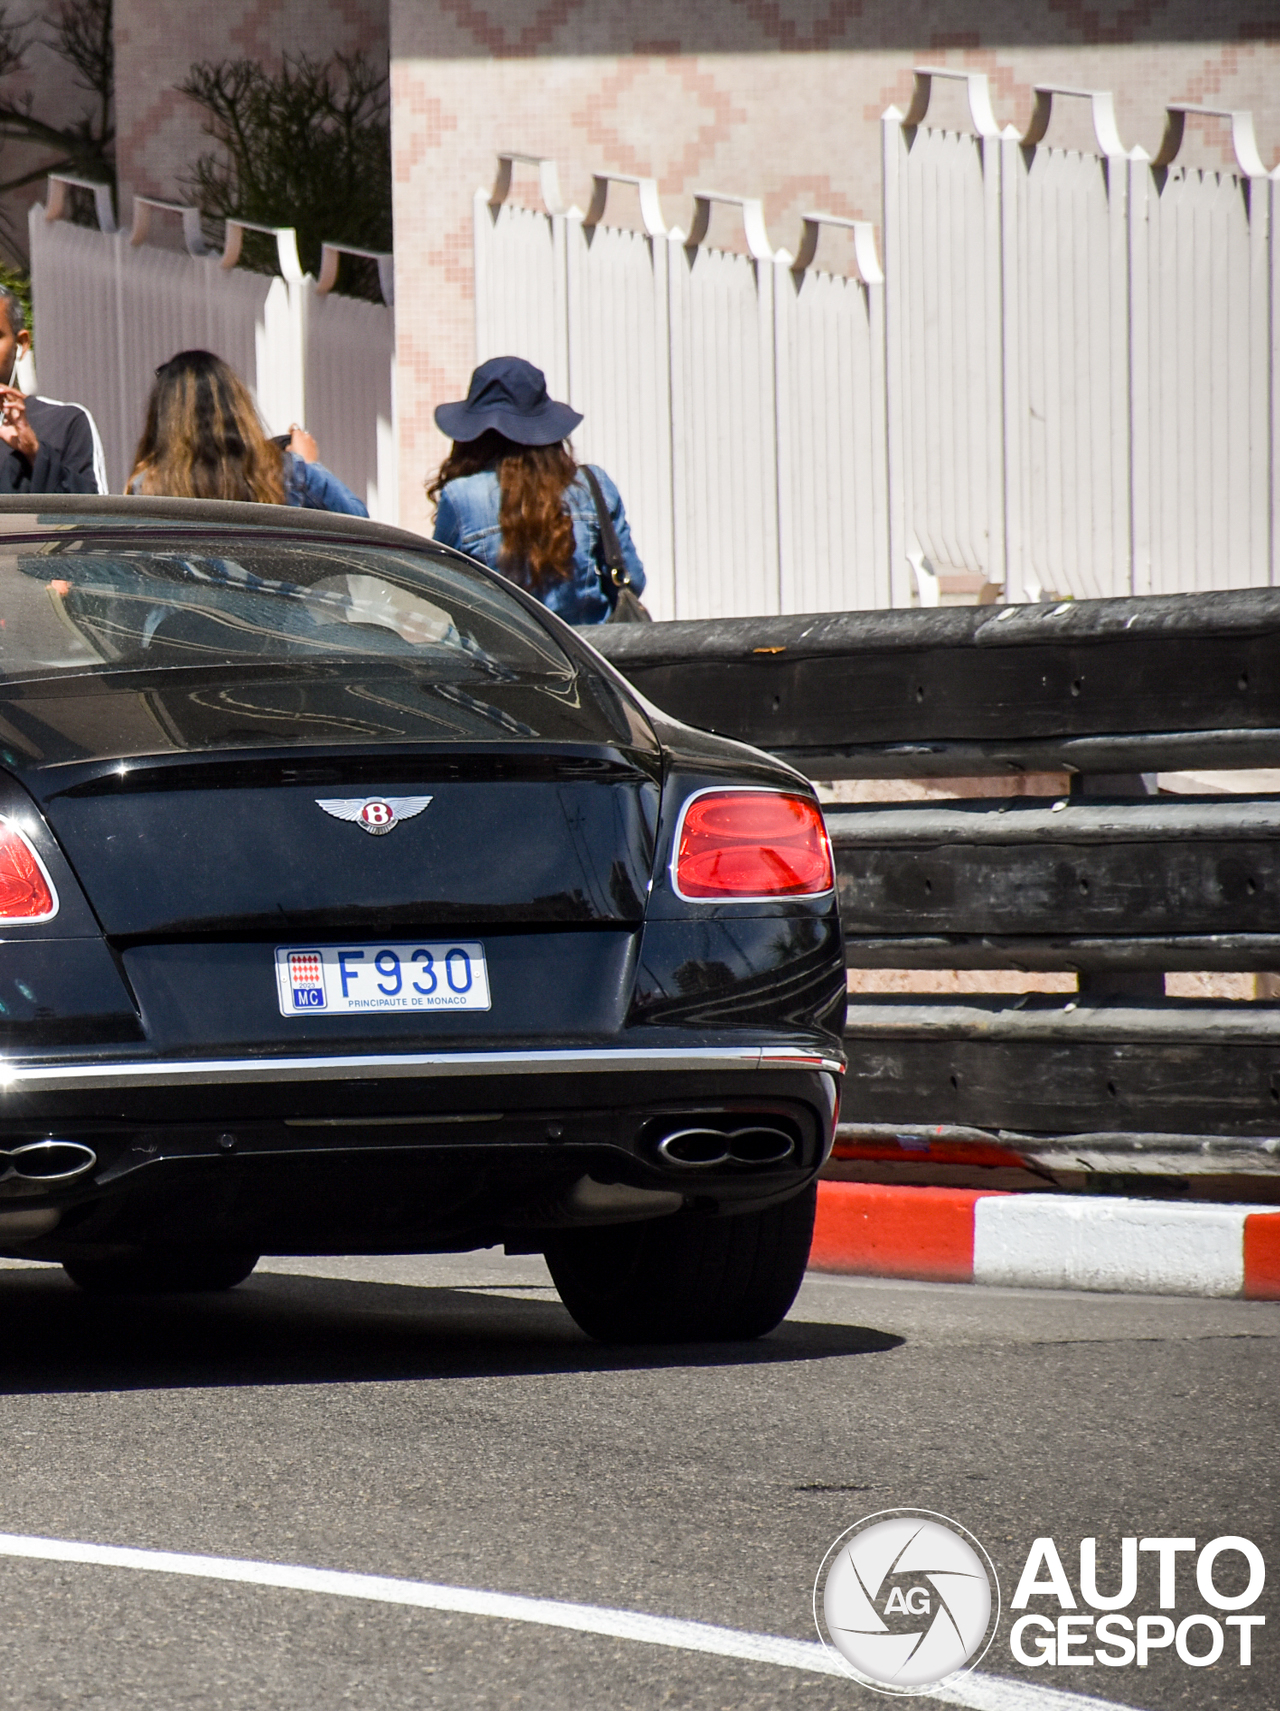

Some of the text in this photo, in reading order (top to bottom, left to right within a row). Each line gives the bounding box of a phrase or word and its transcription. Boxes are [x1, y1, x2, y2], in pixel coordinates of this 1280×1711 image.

[365, 803, 389, 826] B
[337, 948, 473, 998] F930
[298, 990, 319, 1006] MC
[348, 996, 467, 1008] PRINCIPAUTE DE MONACO
